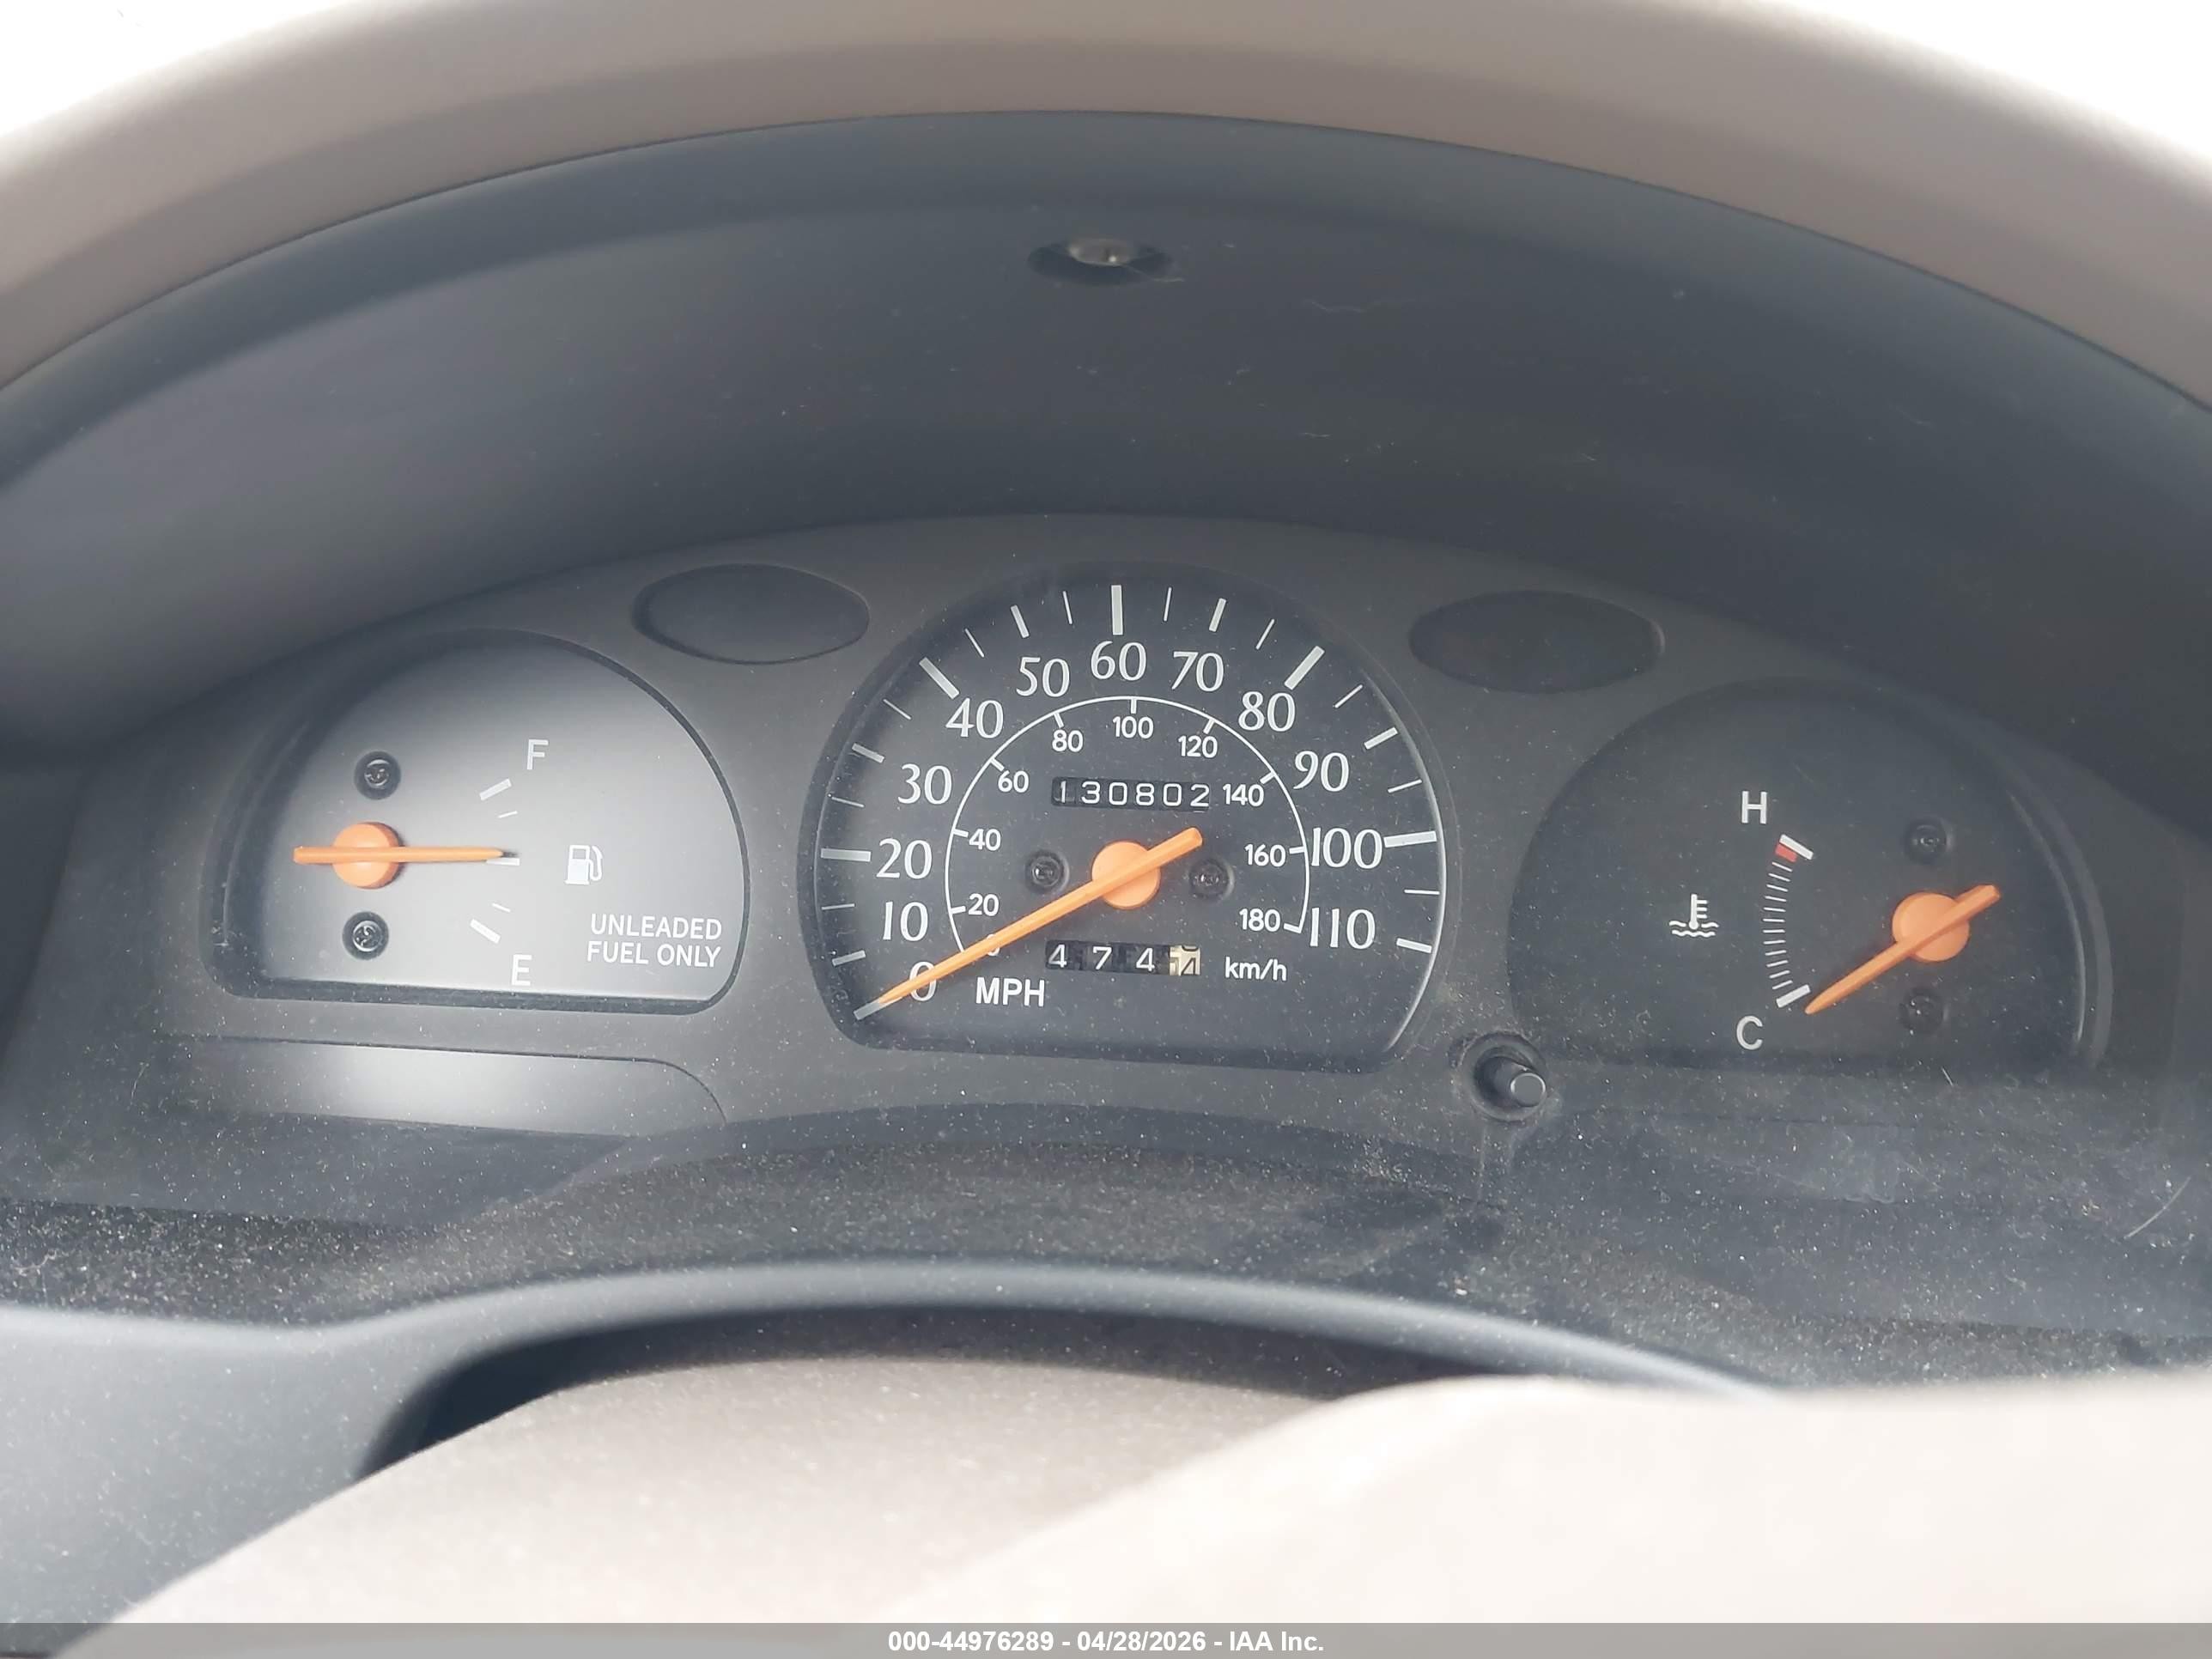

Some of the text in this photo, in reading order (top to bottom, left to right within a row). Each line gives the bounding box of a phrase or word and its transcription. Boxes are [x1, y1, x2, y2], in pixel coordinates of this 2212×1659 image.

[1016, 656, 1070, 697] 50
[1091, 641, 1146, 681] 60
[1171, 651, 1224, 692] 70
[946, 696, 1004, 738] 40
[1112, 715, 1154, 739] 100
[1238, 690, 1296, 732] 80
[526, 738, 549, 770] F
[1052, 729, 1084, 752] 80
[1178, 735, 1218, 758] 120
[897, 763, 952, 805] 30
[998, 769, 1030, 793] 60
[1293, 750, 1349, 792] 90
[1060, 780, 1210, 808] 130802
[1222, 782, 1265, 807] 140
[1741, 790, 1767, 824] H
[969, 828, 1001, 851] 40
[1244, 843, 1286, 867] 160
[1310, 827, 1382, 869] 100
[876, 837, 933, 879] 20
[968, 893, 1000, 916] 20
[1239, 908, 1281, 933] 180
[591, 913, 722, 940] UNLEADED
[883, 901, 928, 942] 10
[1310, 906, 1376, 950] 110
[587, 940, 721, 968] FUEL ONLY
[1224, 956, 1287, 981] km/h
[511, 954, 532, 987] E
[908, 961, 938, 1001] 0
[975, 976, 1045, 1007] MPH
[1736, 1015, 1764, 1050] C
